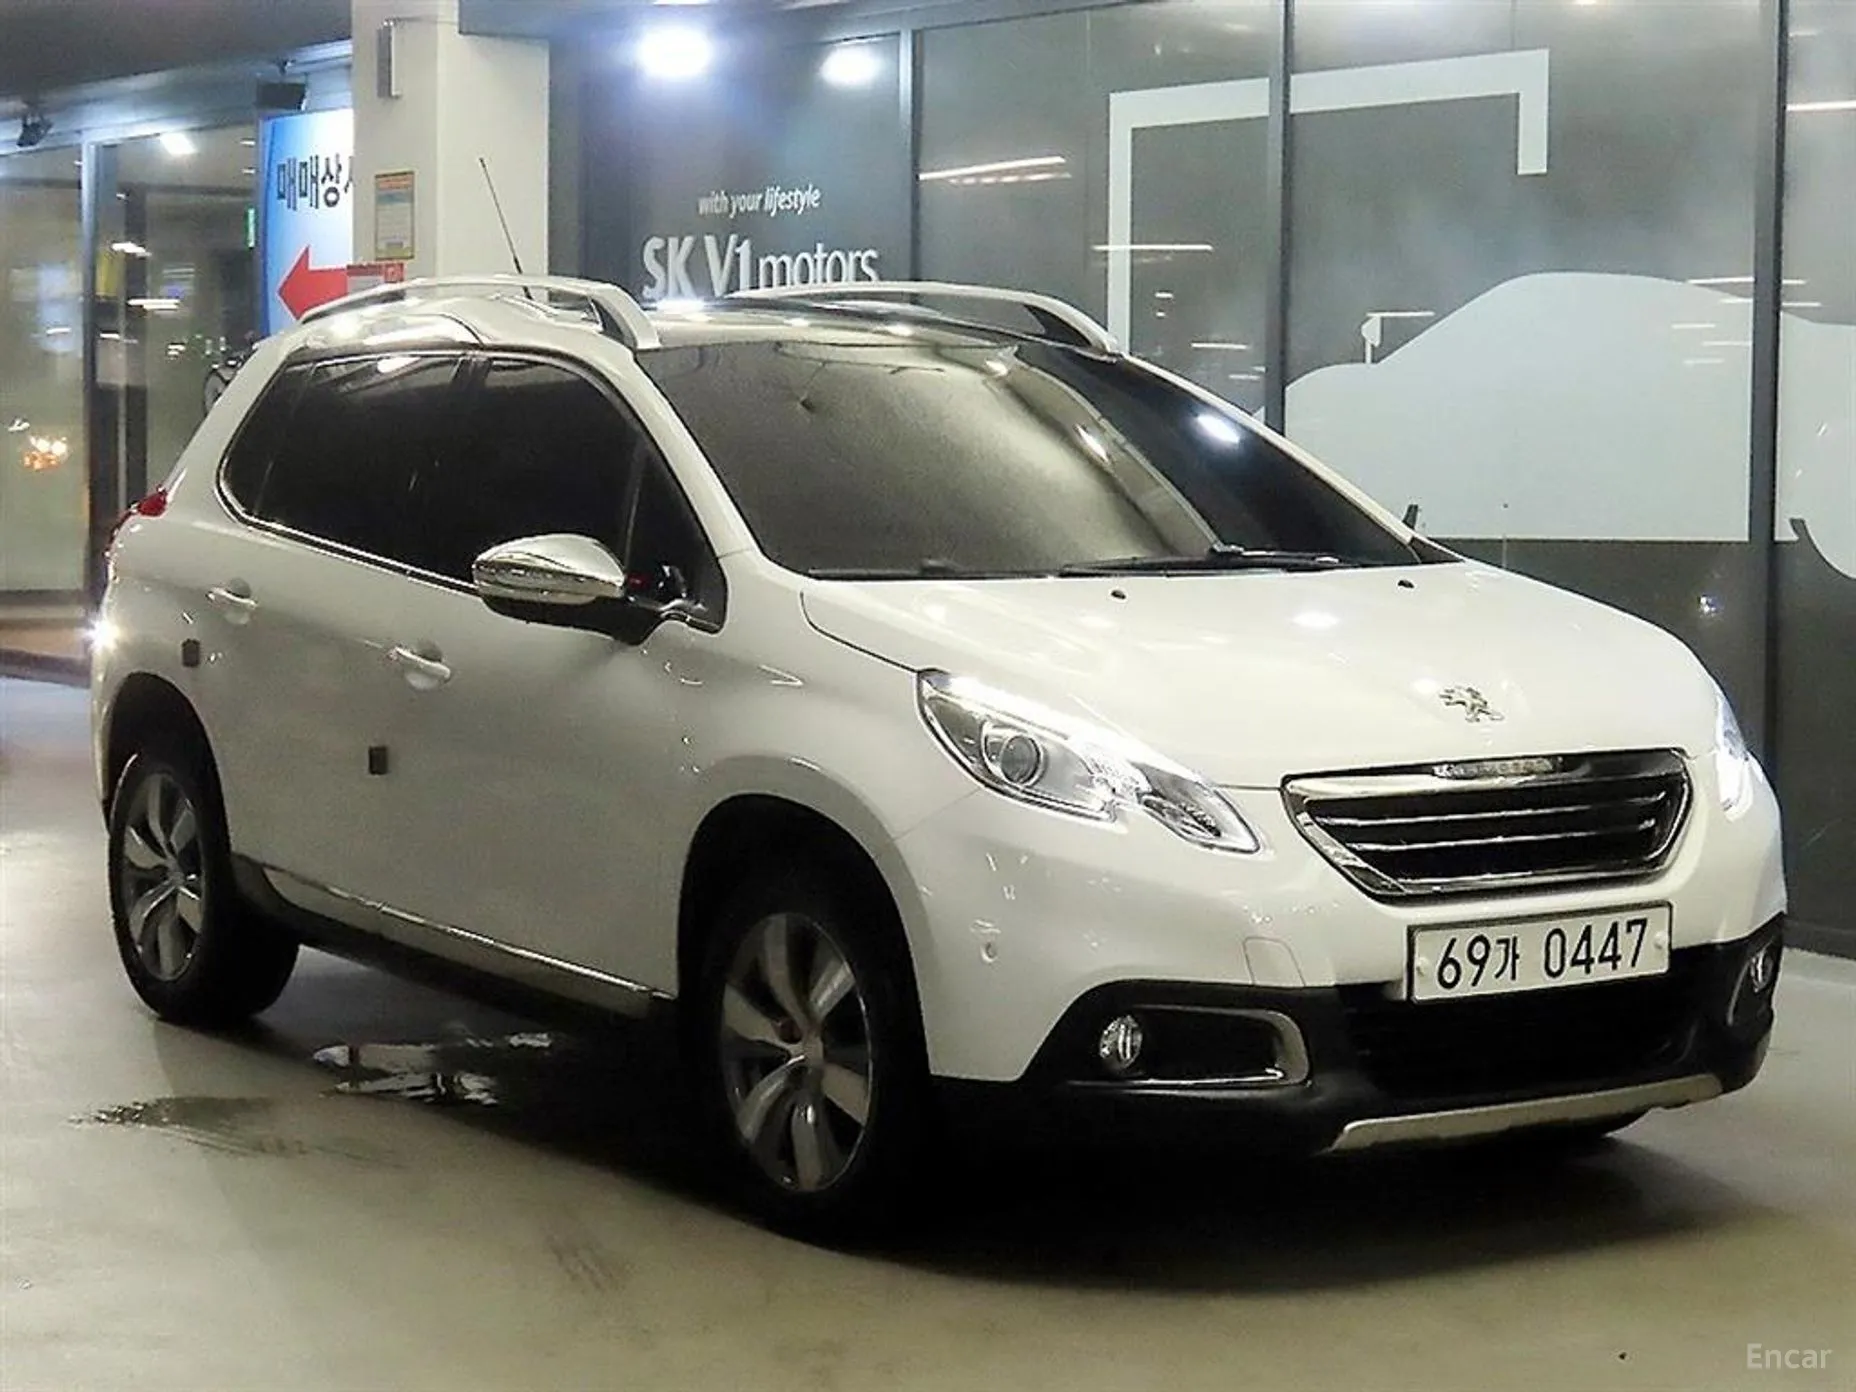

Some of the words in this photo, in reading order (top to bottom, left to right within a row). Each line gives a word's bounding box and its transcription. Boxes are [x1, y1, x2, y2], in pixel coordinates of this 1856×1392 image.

[698, 190, 729, 216] with
[729, 192, 764, 219] your
[764, 183, 821, 217] lifestyle
[642, 235, 698, 300] SK
[758, 242, 879, 291] motors
[1436, 933, 1521, 990] 69가
[1543, 916, 1648, 979] 0447
